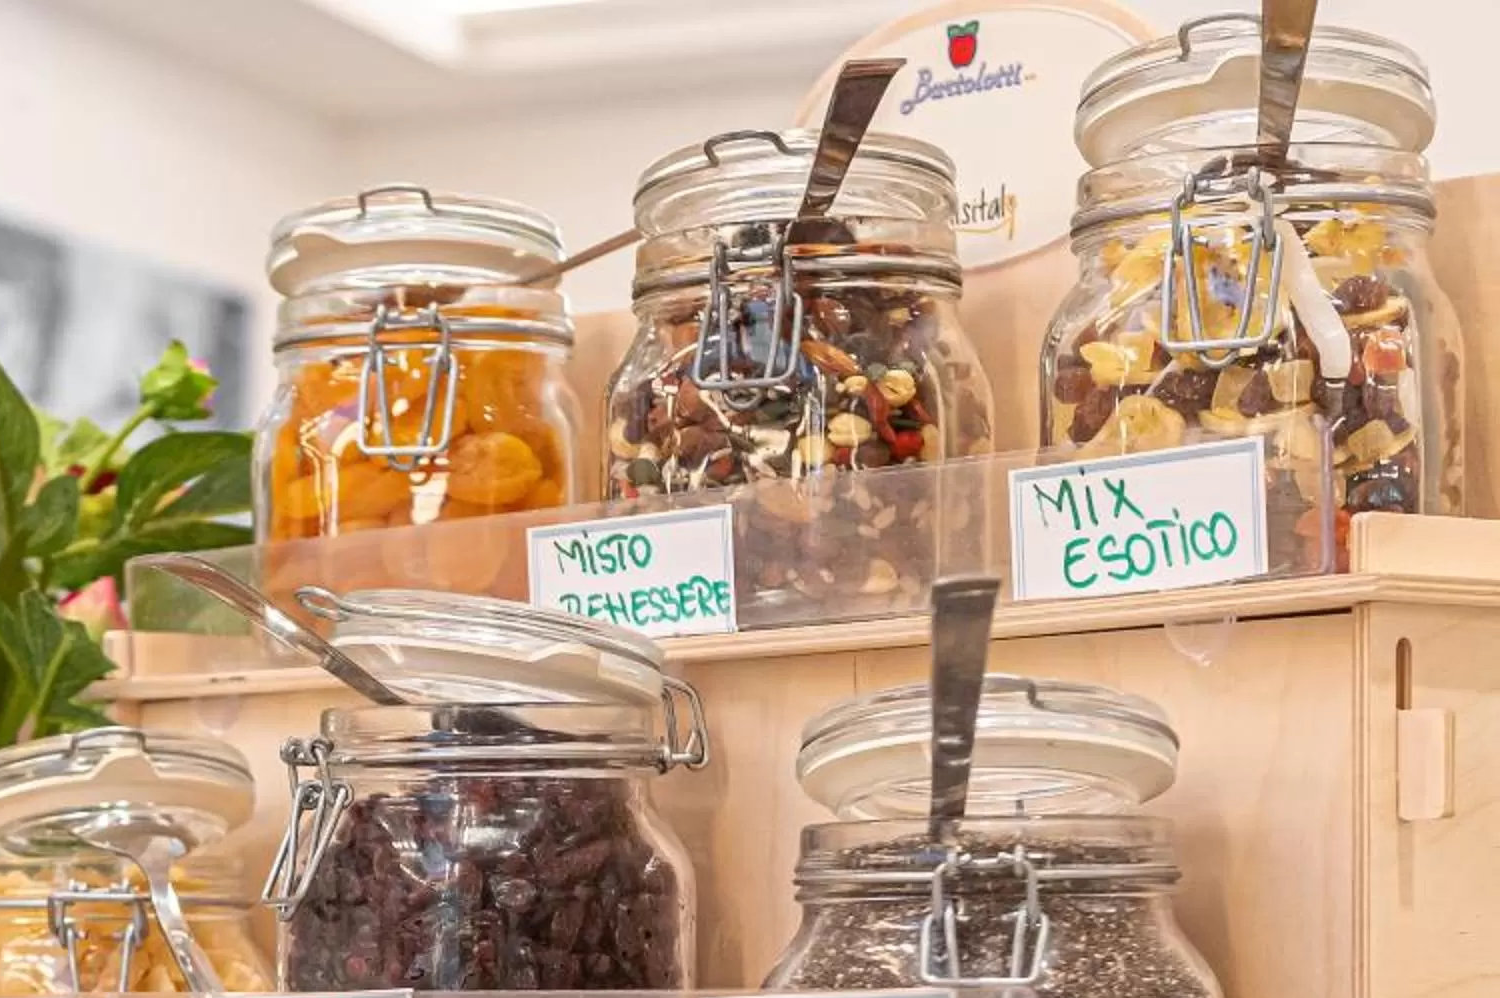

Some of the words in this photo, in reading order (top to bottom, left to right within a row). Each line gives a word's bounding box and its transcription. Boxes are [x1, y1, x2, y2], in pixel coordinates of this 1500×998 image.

[955, 183, 1018, 240] sitaly
[1033, 467, 1144, 530] MIX
[553, 530, 652, 575] MISTO
[1063, 508, 1238, 589] ESOTICO
